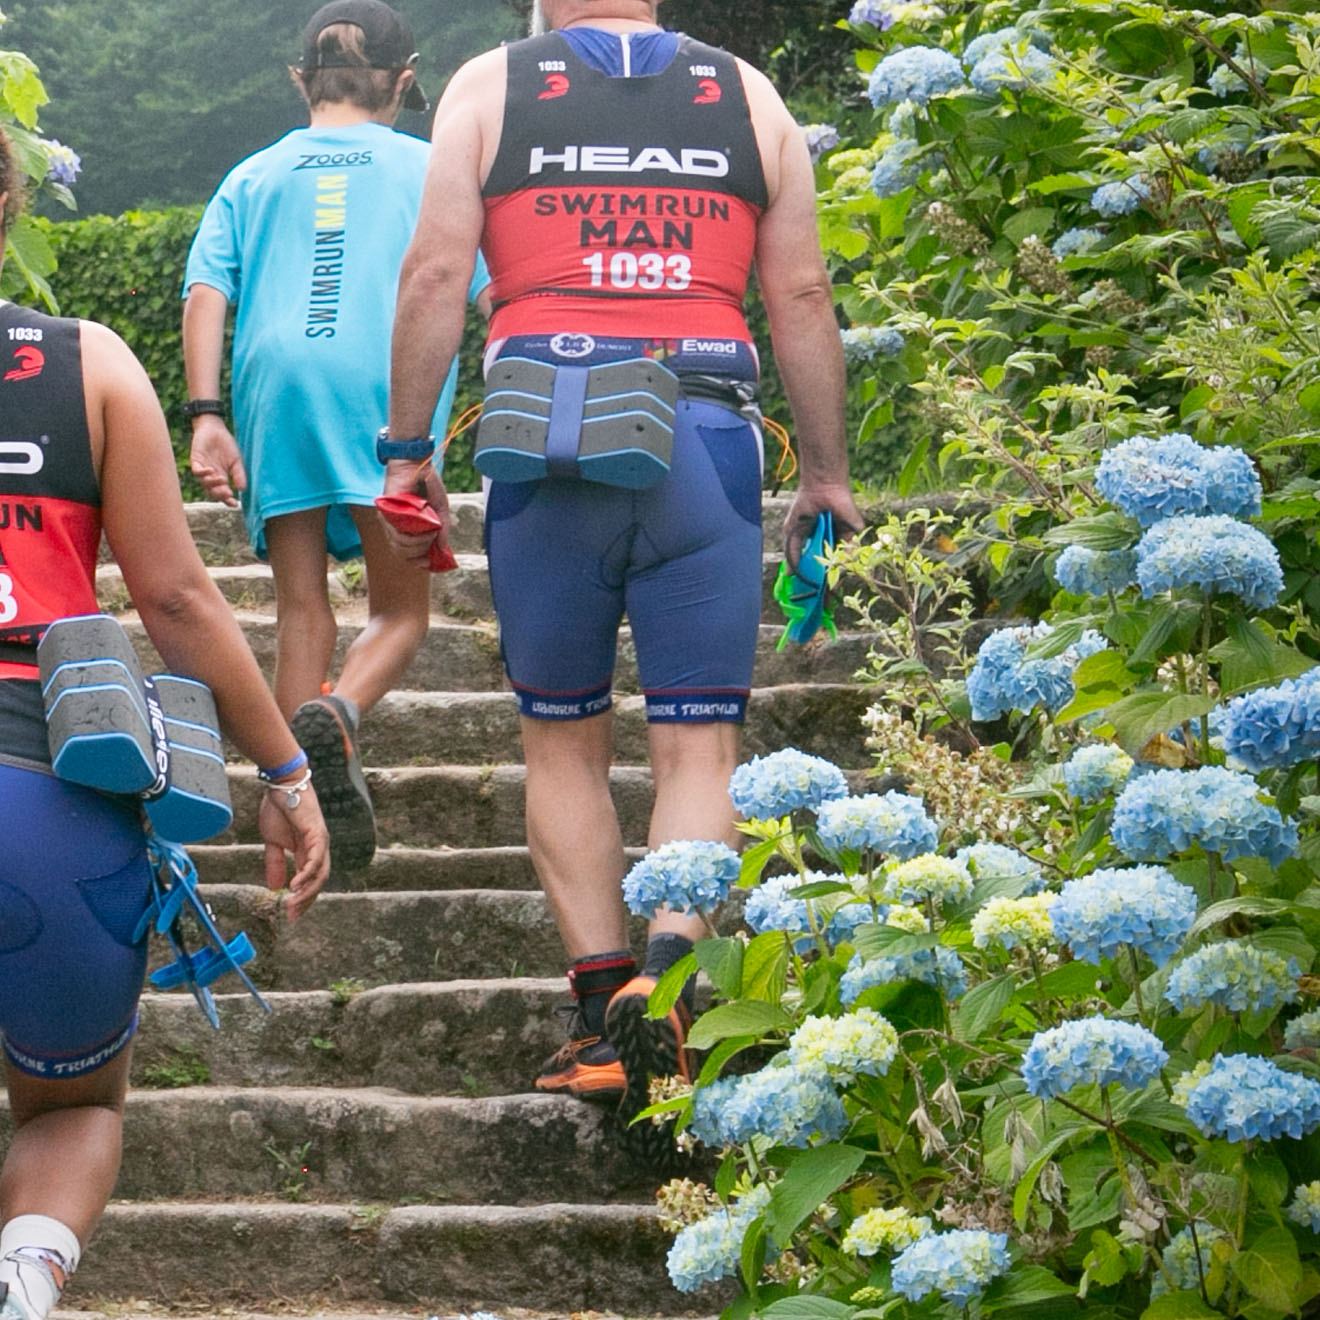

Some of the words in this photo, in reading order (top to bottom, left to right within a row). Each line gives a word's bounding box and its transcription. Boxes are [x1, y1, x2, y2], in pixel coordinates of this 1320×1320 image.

[537, 60, 566, 72] 1033
[688, 64, 717, 77] 1033
[291, 150, 373, 171] ZOGGS
[529, 146, 729, 178] HEAD
[534, 193, 729, 221] SWIMRUN
[581, 220, 693, 250] MAN
[582, 252, 692, 291] 1033
[7, 327, 43, 342] 1033
[682, 339, 736, 354] Ewad
